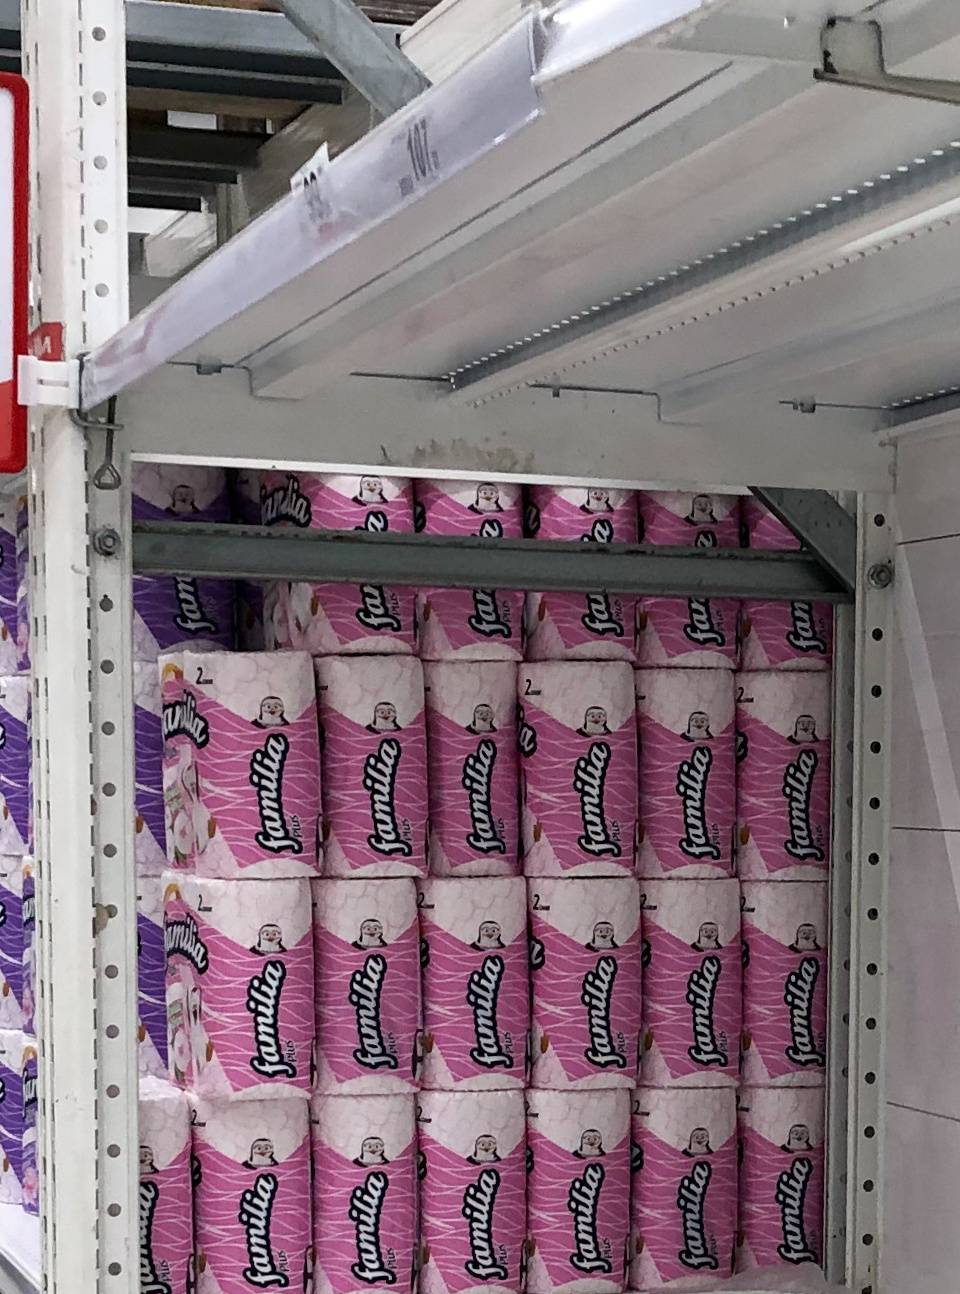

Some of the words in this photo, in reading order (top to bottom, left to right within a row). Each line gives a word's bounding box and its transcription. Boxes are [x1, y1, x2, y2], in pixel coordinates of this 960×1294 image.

[251, 734, 301, 852] familia
[364, 740, 411, 855] familia
[463, 741, 506, 853] familia
[575, 743, 620, 856] familia
[677, 748, 720, 858] familia
[783, 750, 824, 859] familia
[248, 961, 296, 1077] familia
[350, 955, 397, 1068] familia
[468, 957, 513, 1067] familia
[583, 957, 626, 1067] familia
[688, 957, 727, 1065] familia
[785, 958, 825, 1065] familia
[240, 1174, 288, 1287] familia
[350, 1172, 397, 1283] familia
[463, 1170, 508, 1279] familia
[569, 1164, 612, 1272] familia
[678, 1162, 718, 1269] familia
[776, 1158, 816, 1263] familia
